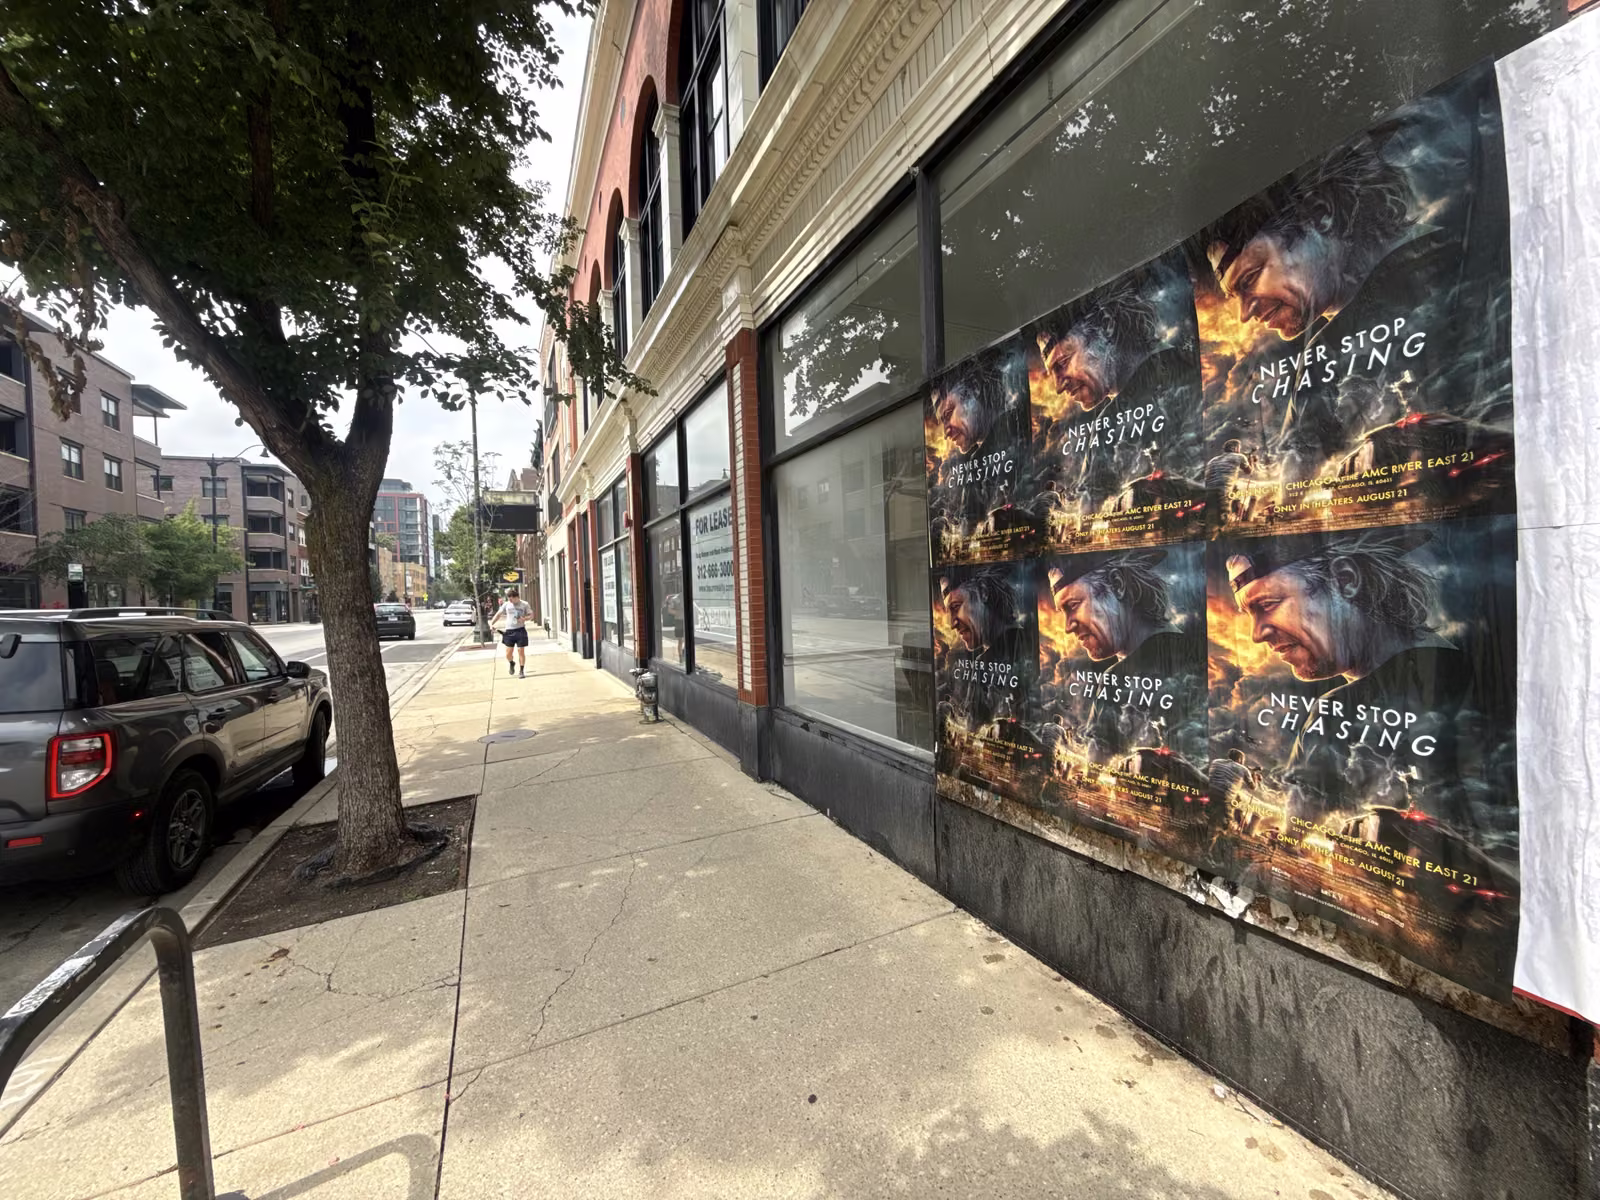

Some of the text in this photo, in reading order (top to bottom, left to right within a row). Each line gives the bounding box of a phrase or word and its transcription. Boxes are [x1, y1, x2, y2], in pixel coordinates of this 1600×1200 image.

[1260, 317, 1406, 382] NEVER STOP
[1252, 331, 1427, 404] CHASING
[1062, 415, 1165, 456] CHASING
[1068, 403, 1154, 439] NEVER STOP
[948, 460, 1013, 489] CHASING
[952, 450, 1006, 476] NEVER STOP
[1285, 475, 1333, 491] CHICAGO
[1362, 466, 1389, 479] AMC
[1391, 460, 1423, 474] RIVER
[1427, 454, 1456, 469] EAST
[1461, 452, 1475, 463] 21
[1143, 504, 1162, 514] RIVER
[1163, 501, 1181, 511] EAST
[1183, 499, 1193, 508] 21
[1273, 488, 1408, 514] ONLY IN THEATERS AUGUST 21
[695, 506, 732, 536] FOR LEASE
[1121, 524, 1146, 533] AUGUST
[953, 668, 1019, 688] CHASING
[958, 658, 1012, 674] NEVER STOP
[1076, 670, 1163, 691] NEVER STOP
[1069, 682, 1175, 710] CHASING
[1270, 692, 1417, 729] NEVER STOP
[1257, 708, 1438, 757] CHASING
[1130, 789, 1153, 801] AUGUST
[1133, 774, 1149, 783] AMC
[1151, 777, 1170, 788] RIVER
[1171, 782, 1190, 793] EAST
[1191, 788, 1200, 796] 21
[1276, 832, 1299, 846] ONLY
[1300, 840, 1311, 851] IN
[1313, 846, 1355, 867] THEATERS
[1359, 861, 1395, 881] AUGUST
[1396, 877, 1405, 887] 21
[1289, 816, 1336, 837] CHICAGO
[1365, 840, 1391, 856] AMC
[1393, 849, 1420, 868] RIVER
[1425, 861, 1459, 880] EAST
[1463, 873, 1478, 886] 21
